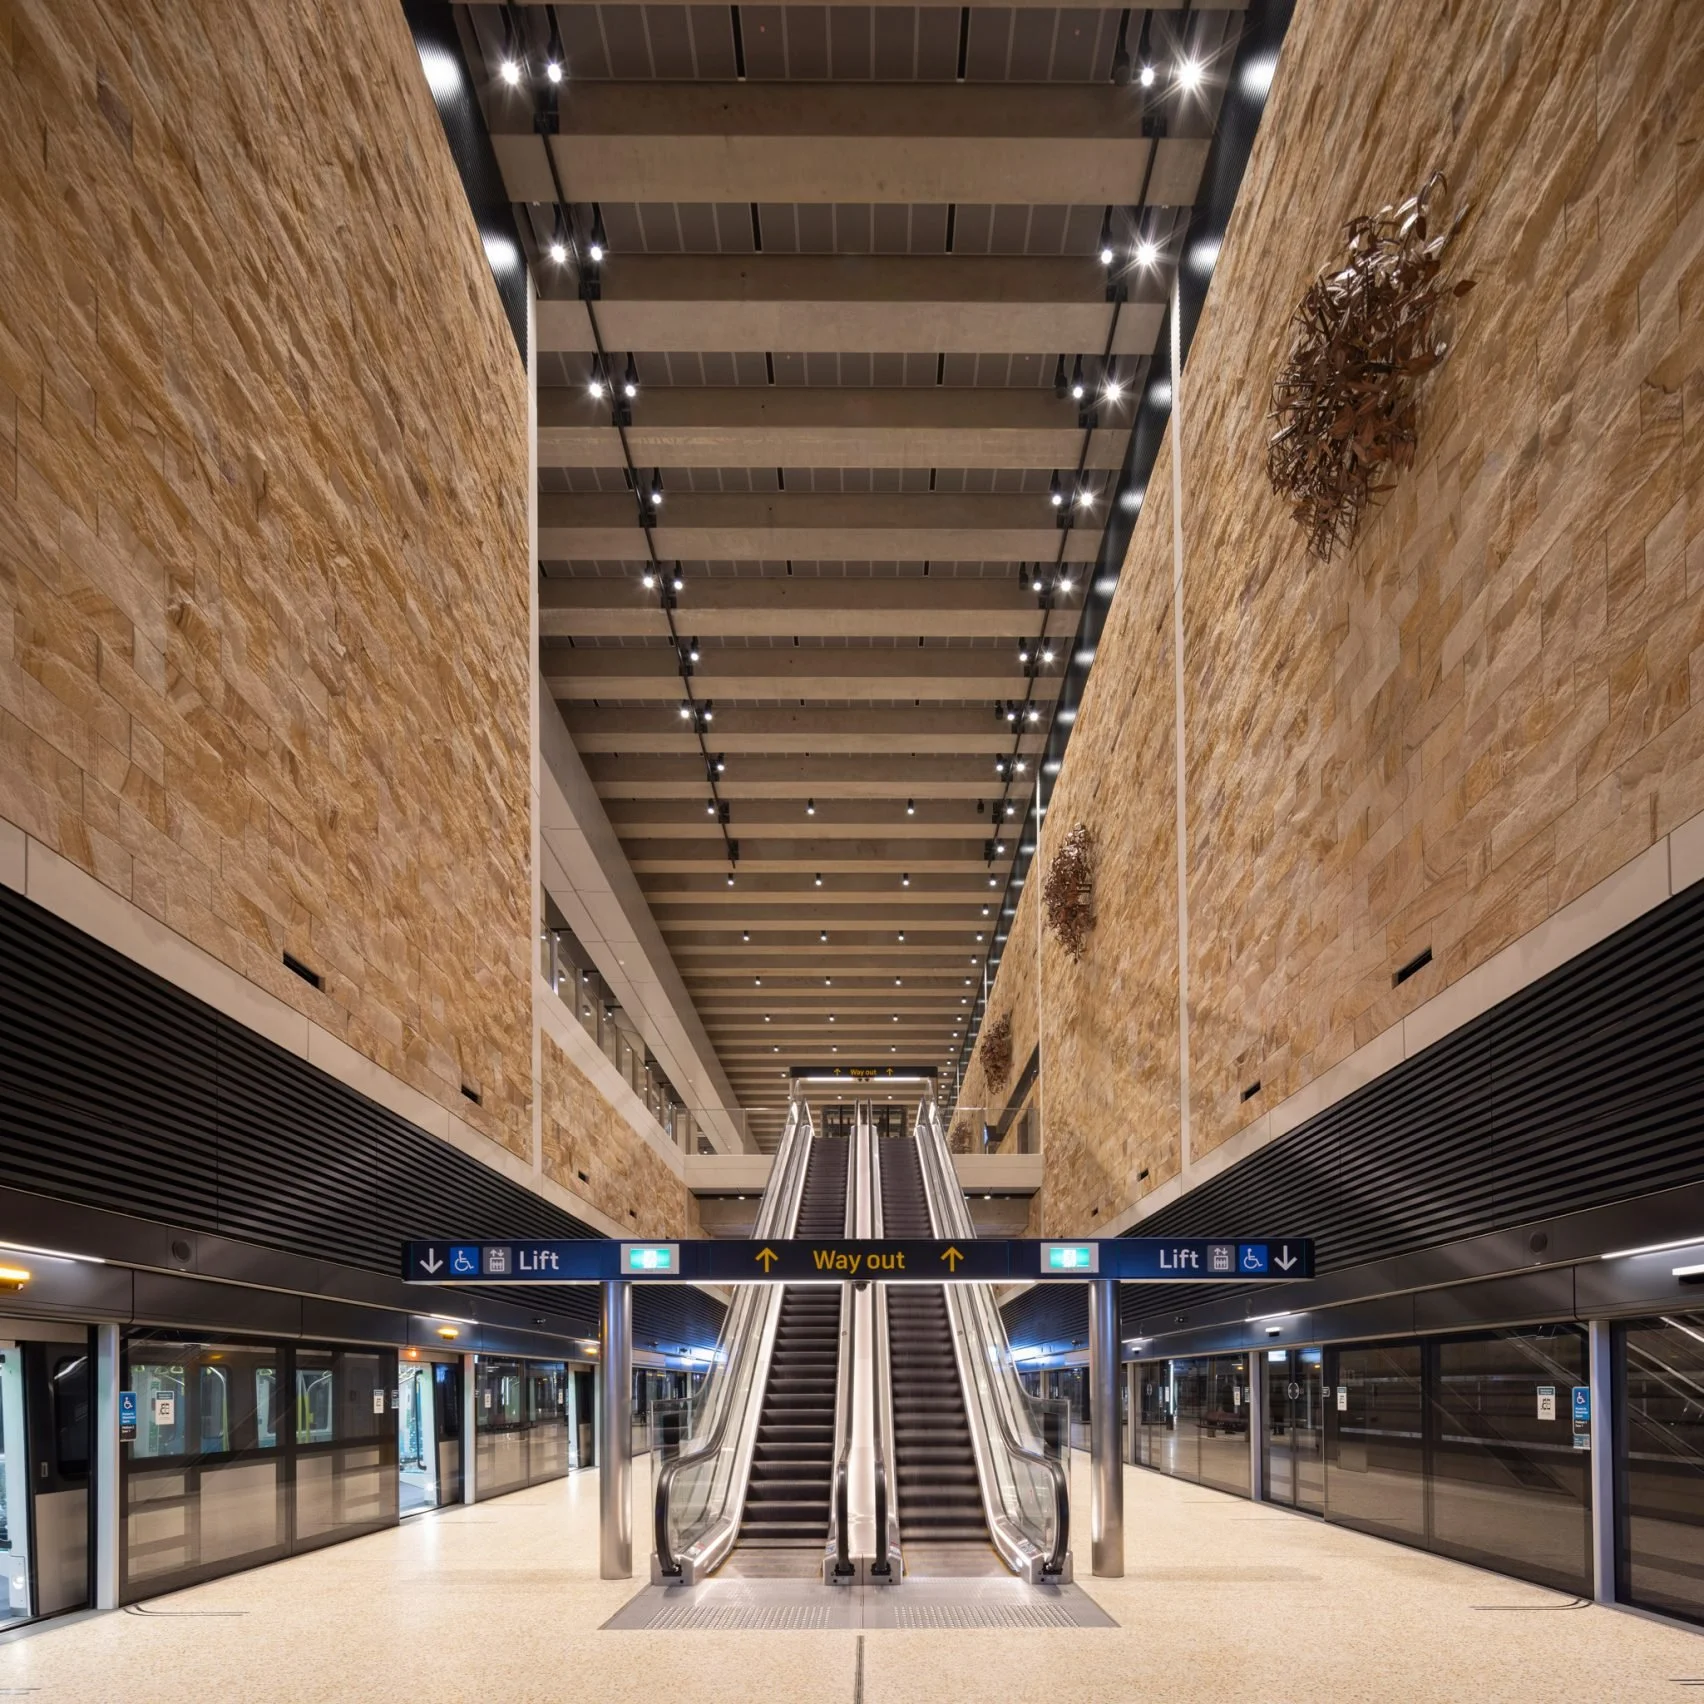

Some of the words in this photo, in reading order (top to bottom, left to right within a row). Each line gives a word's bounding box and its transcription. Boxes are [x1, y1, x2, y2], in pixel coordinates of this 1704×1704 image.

[520, 1250, 559, 1270] Lift
[813, 1250, 862, 1274] Way
[866, 1251, 905, 1269] out
[1160, 1249, 1199, 1269] Lift
